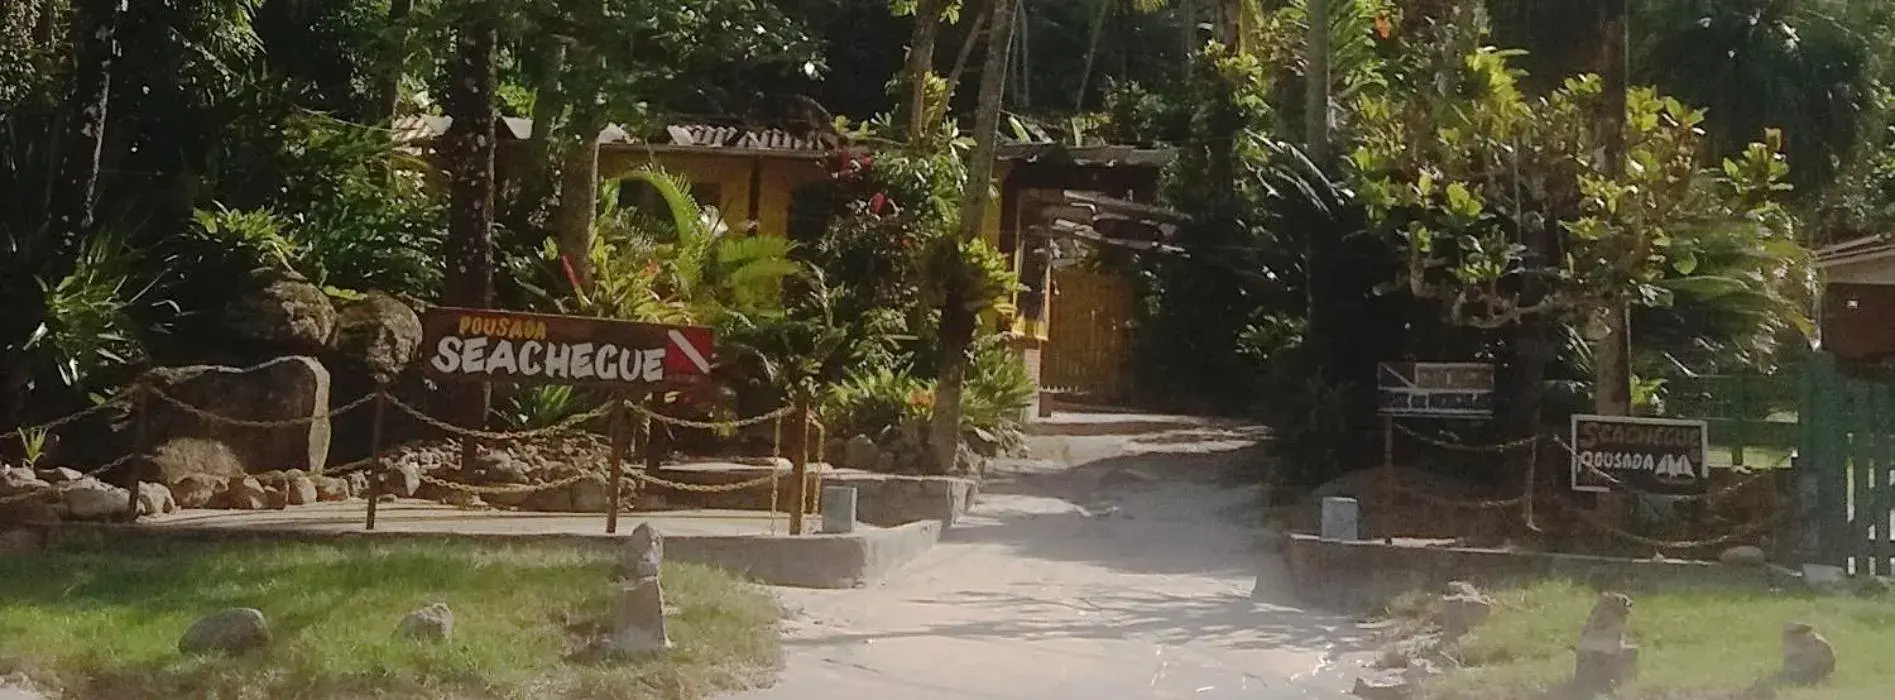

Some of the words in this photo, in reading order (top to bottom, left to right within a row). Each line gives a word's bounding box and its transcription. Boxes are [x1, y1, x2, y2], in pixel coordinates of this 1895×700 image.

[458, 315, 547, 340] POUSADA
[430, 336, 666, 381] SEACHEGUE
[1576, 450, 1655, 473] POUSADA
